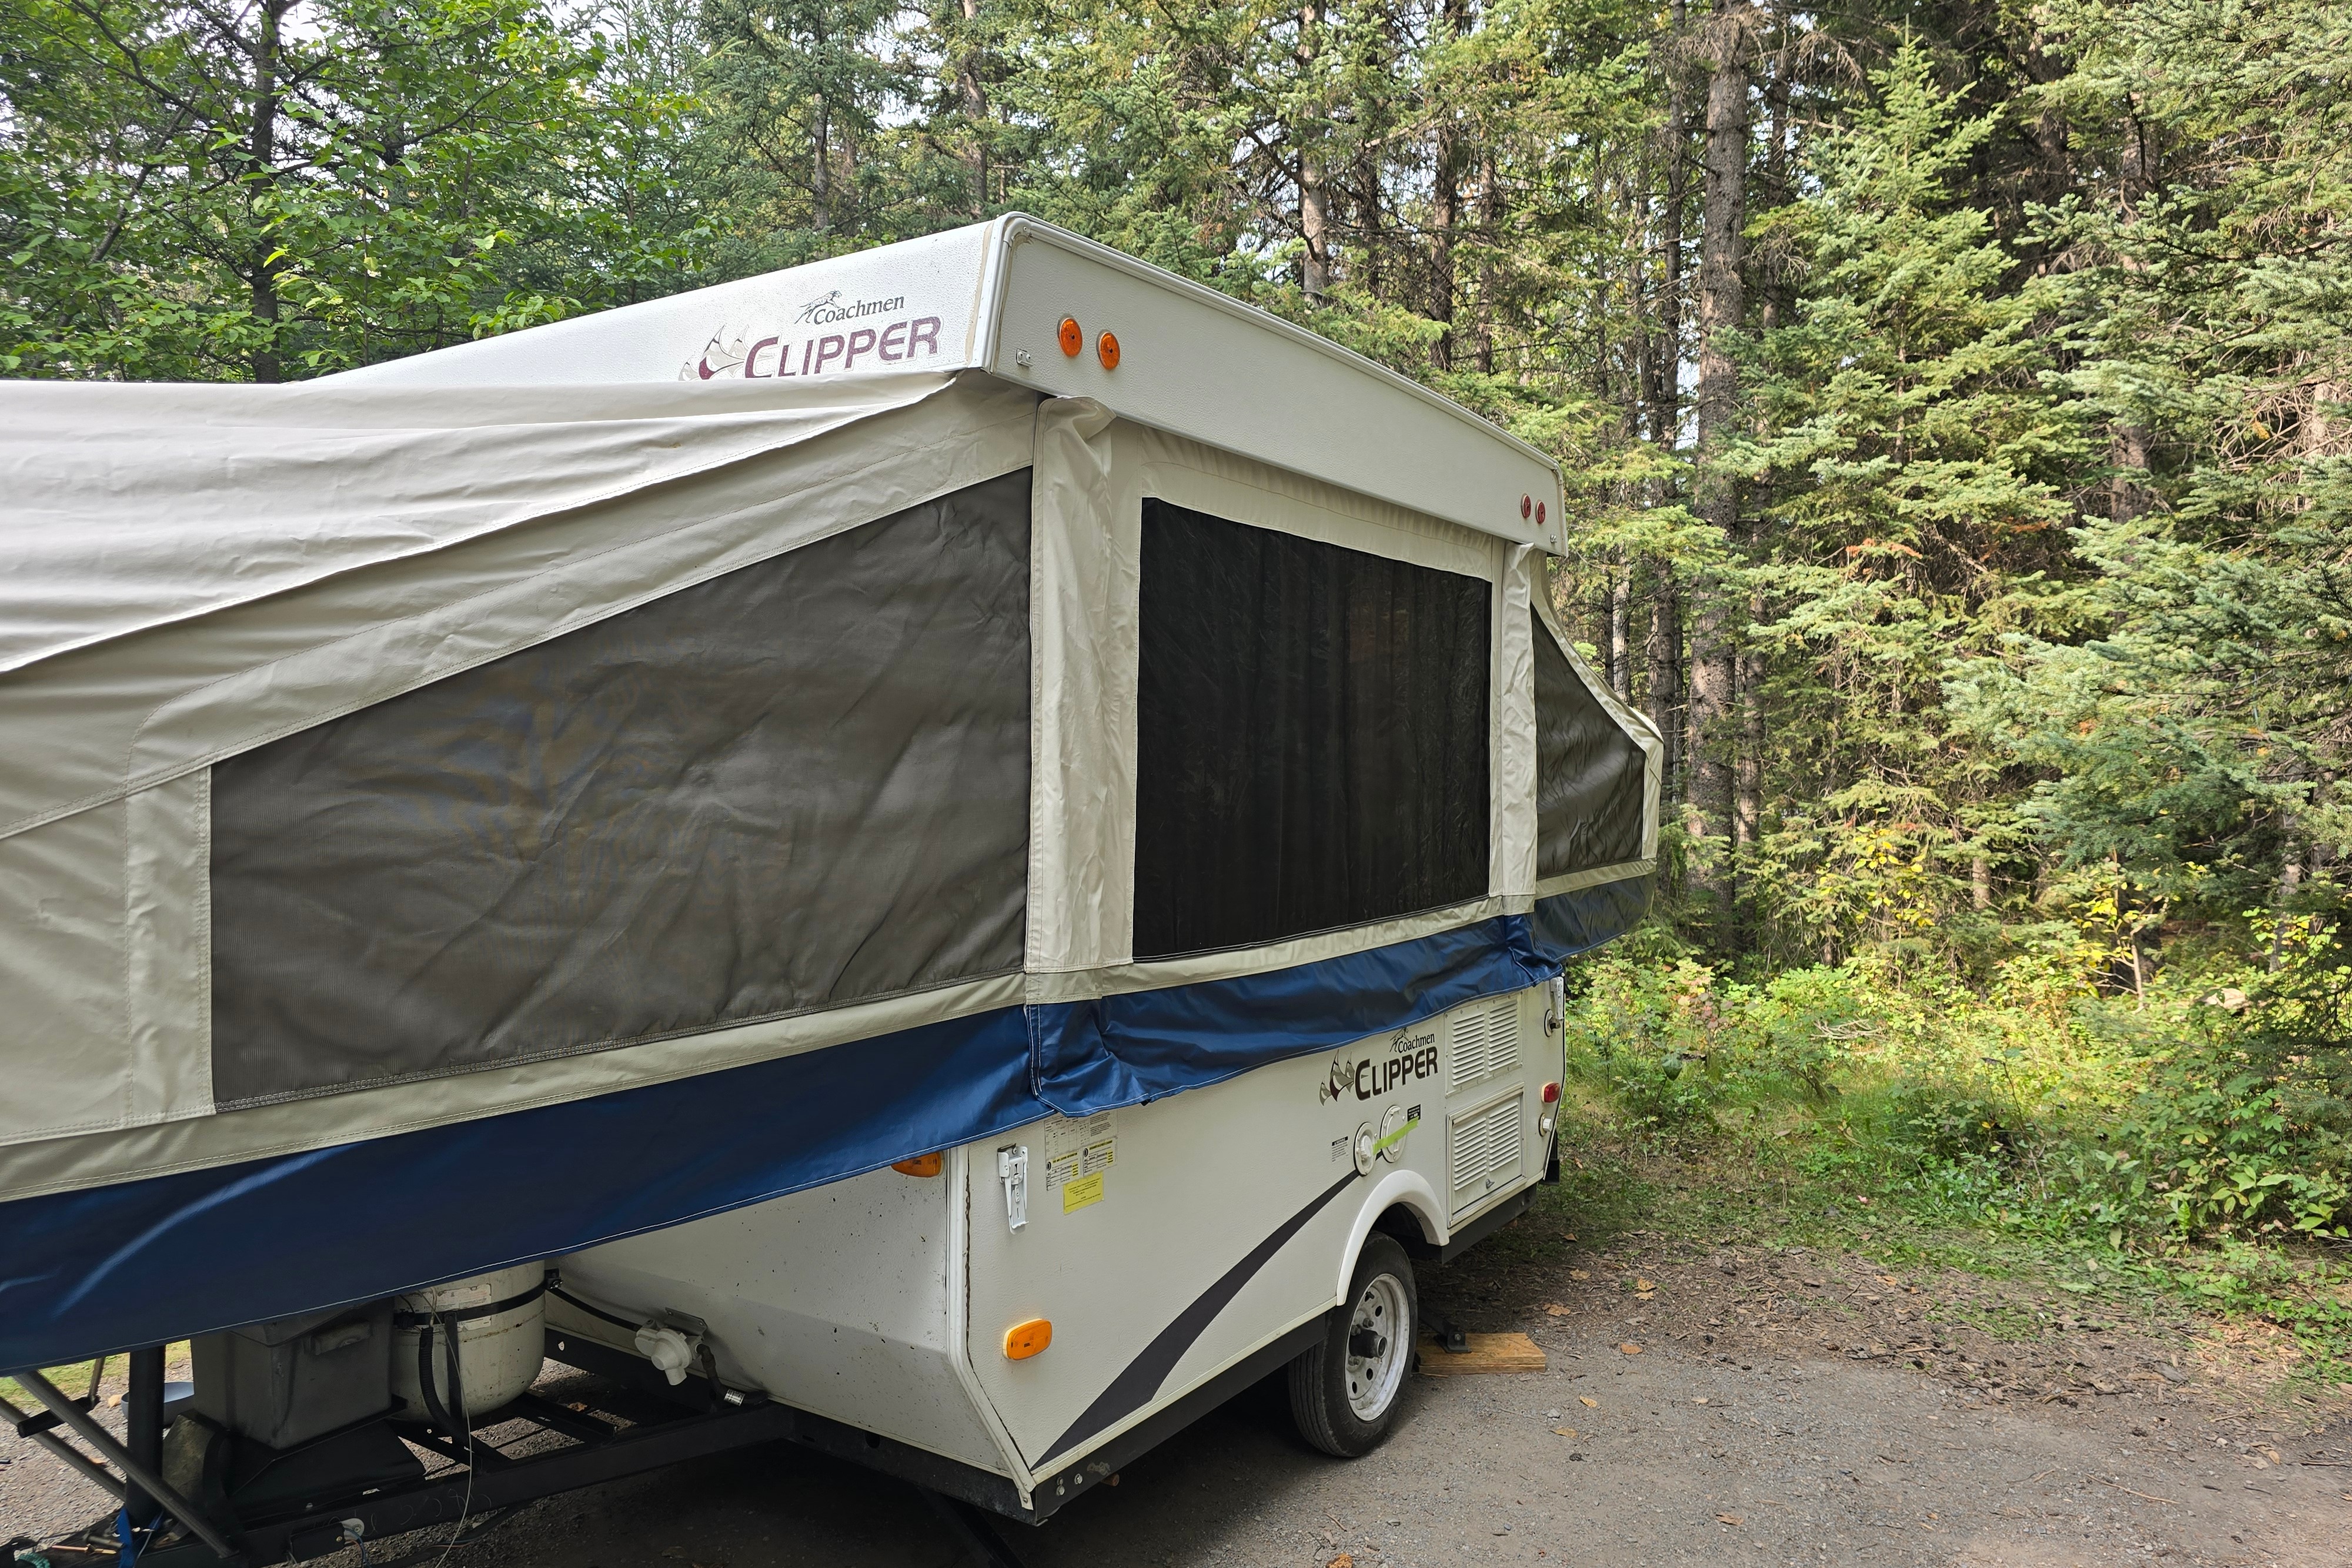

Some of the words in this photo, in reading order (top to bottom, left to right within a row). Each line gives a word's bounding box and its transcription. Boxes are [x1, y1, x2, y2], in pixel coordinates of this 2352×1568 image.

[814, 296, 905, 325] Coachmen
[745, 316, 941, 378] CLIPPER
[1398, 1033, 1435, 1054] Coachmen
[1355, 1046, 1438, 1101] CLIPPER
